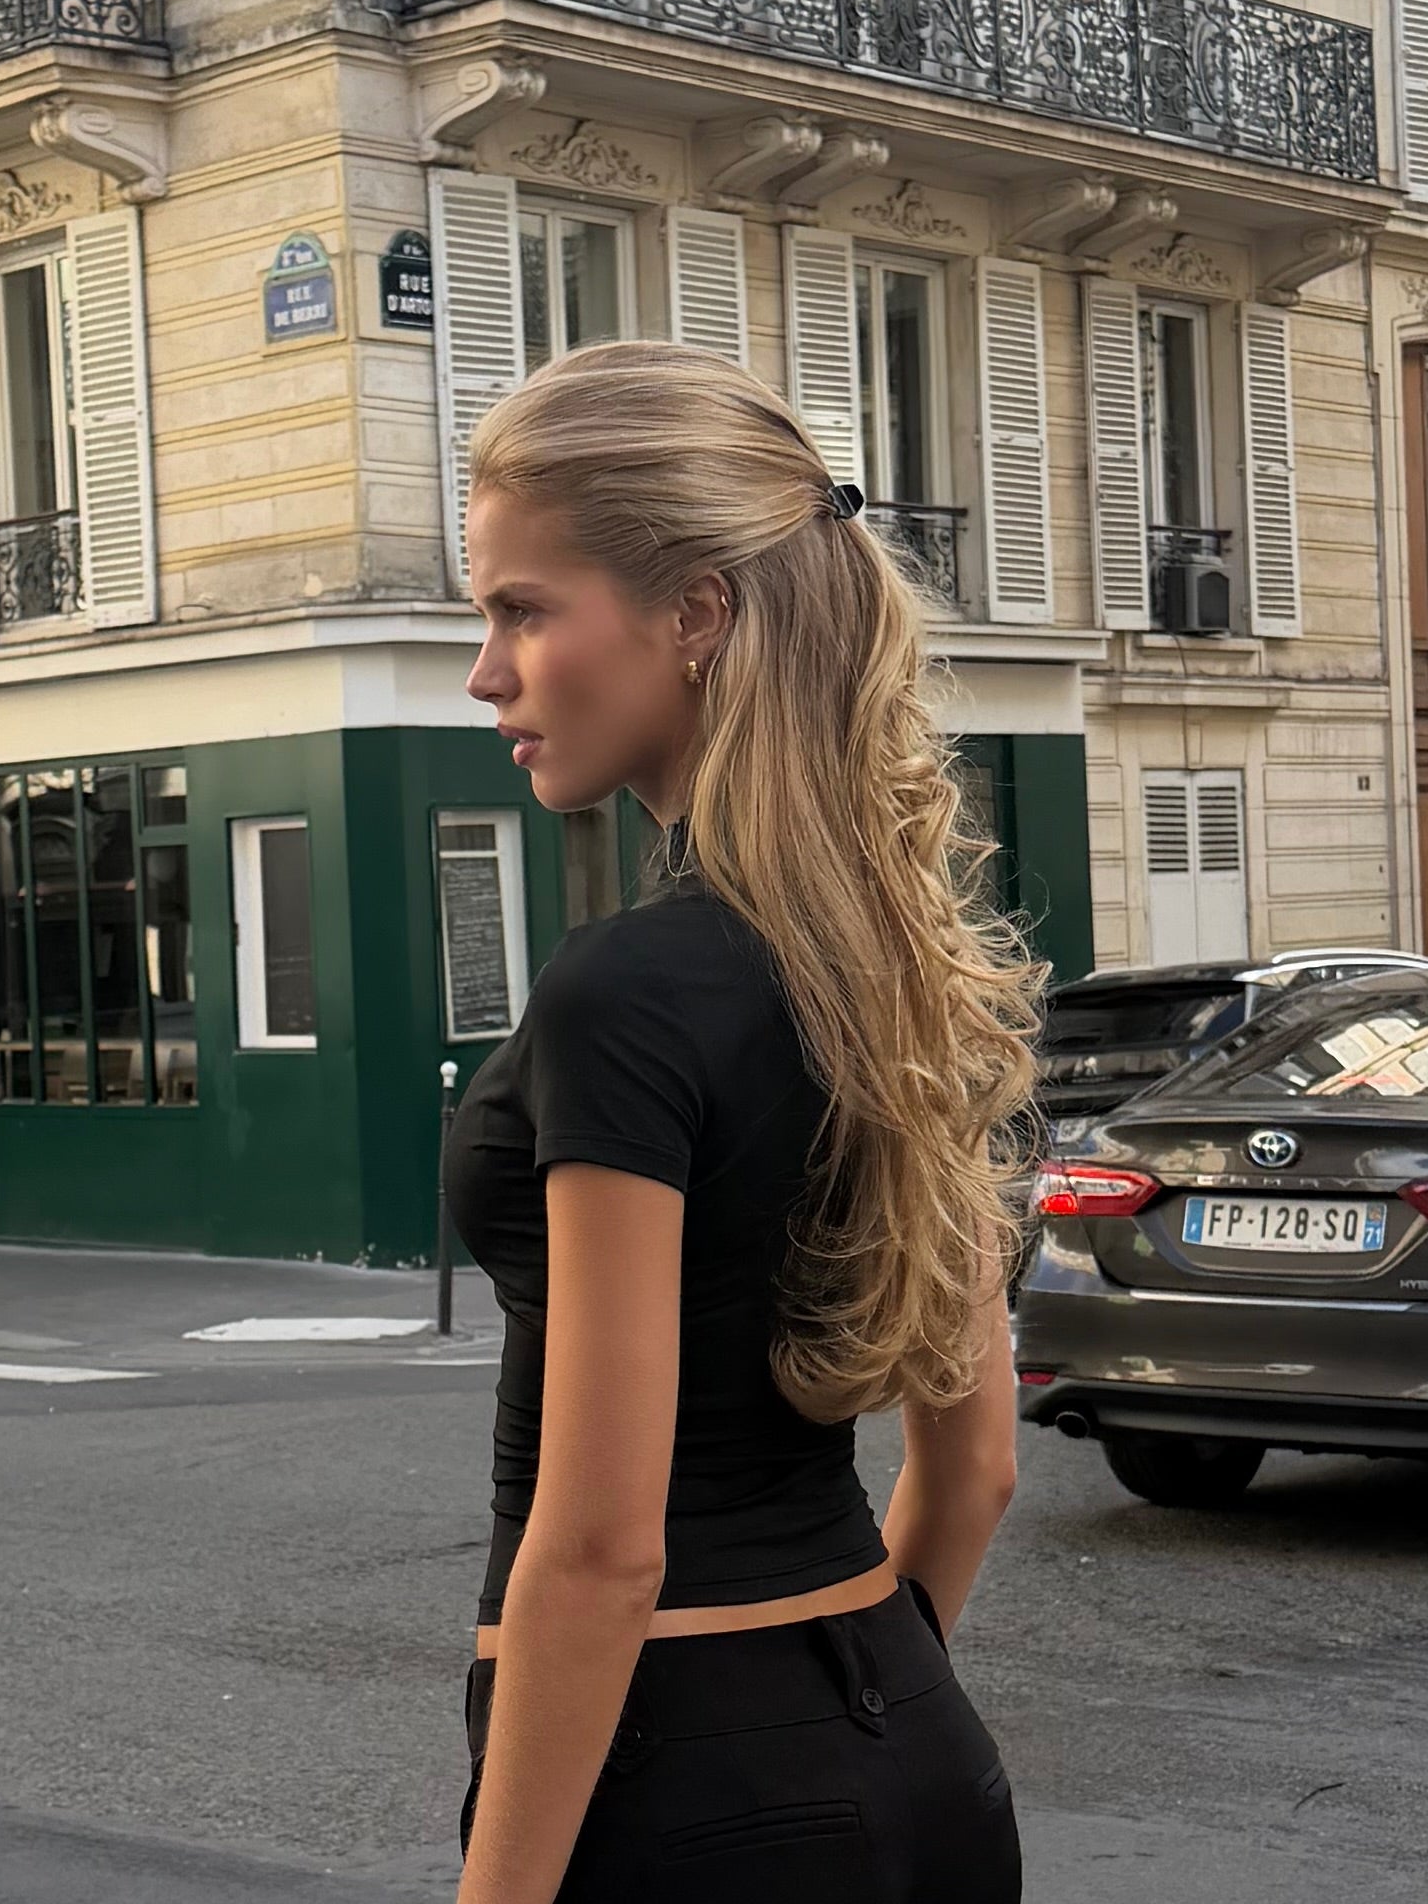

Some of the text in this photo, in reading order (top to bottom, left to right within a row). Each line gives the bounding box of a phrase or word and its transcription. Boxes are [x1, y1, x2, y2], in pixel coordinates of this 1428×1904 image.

[399, 273, 431, 293] RUE
[386, 294, 433, 316] D'ARTO
[1208, 1204, 1359, 1242] FP-128-SQ
[1365, 1226, 1381, 1243] 71
